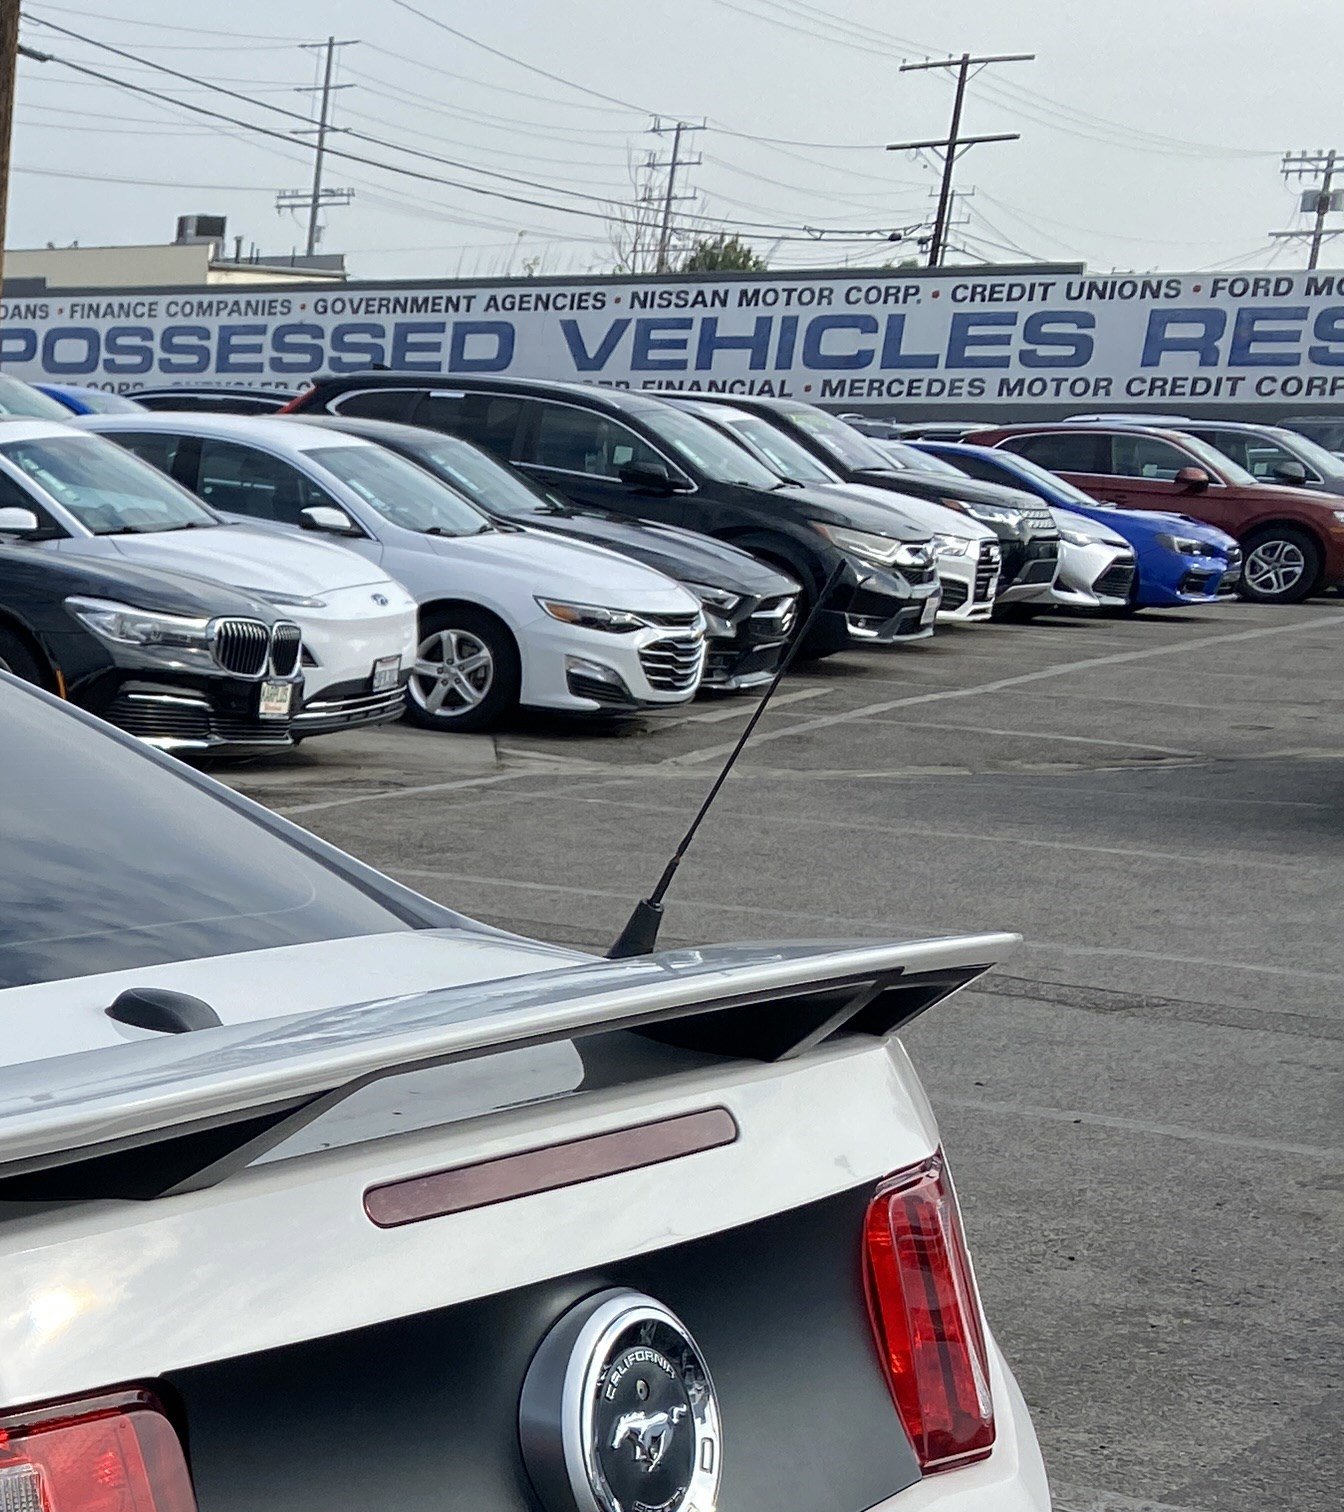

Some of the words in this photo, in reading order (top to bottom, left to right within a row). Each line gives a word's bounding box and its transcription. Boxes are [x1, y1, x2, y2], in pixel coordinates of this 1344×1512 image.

[69, 300, 159, 319] FINANCE
[165, 298, 292, 318] COMPANIES
[314, 294, 477, 315] GOVERNMENT
[483, 291, 607, 312] AGENCIES
[629, 288, 730, 311] NISSAN
[737, 286, 834, 308] MOTOR
[844, 285, 922, 306] CORP.
[950, 281, 1056, 303] CREDIT
[1065, 279, 1182, 301] UNIONS
[1210, 276, 1295, 299] FORD
[559, 310, 1096, 373] VEHICLES
[820, 377, 986, 399] MERCEDES
[997, 376, 1114, 398] MOTOR
[1125, 375, 1247, 398] CREDIT
[605, 1350, 677, 1402] CALIFORNIA
